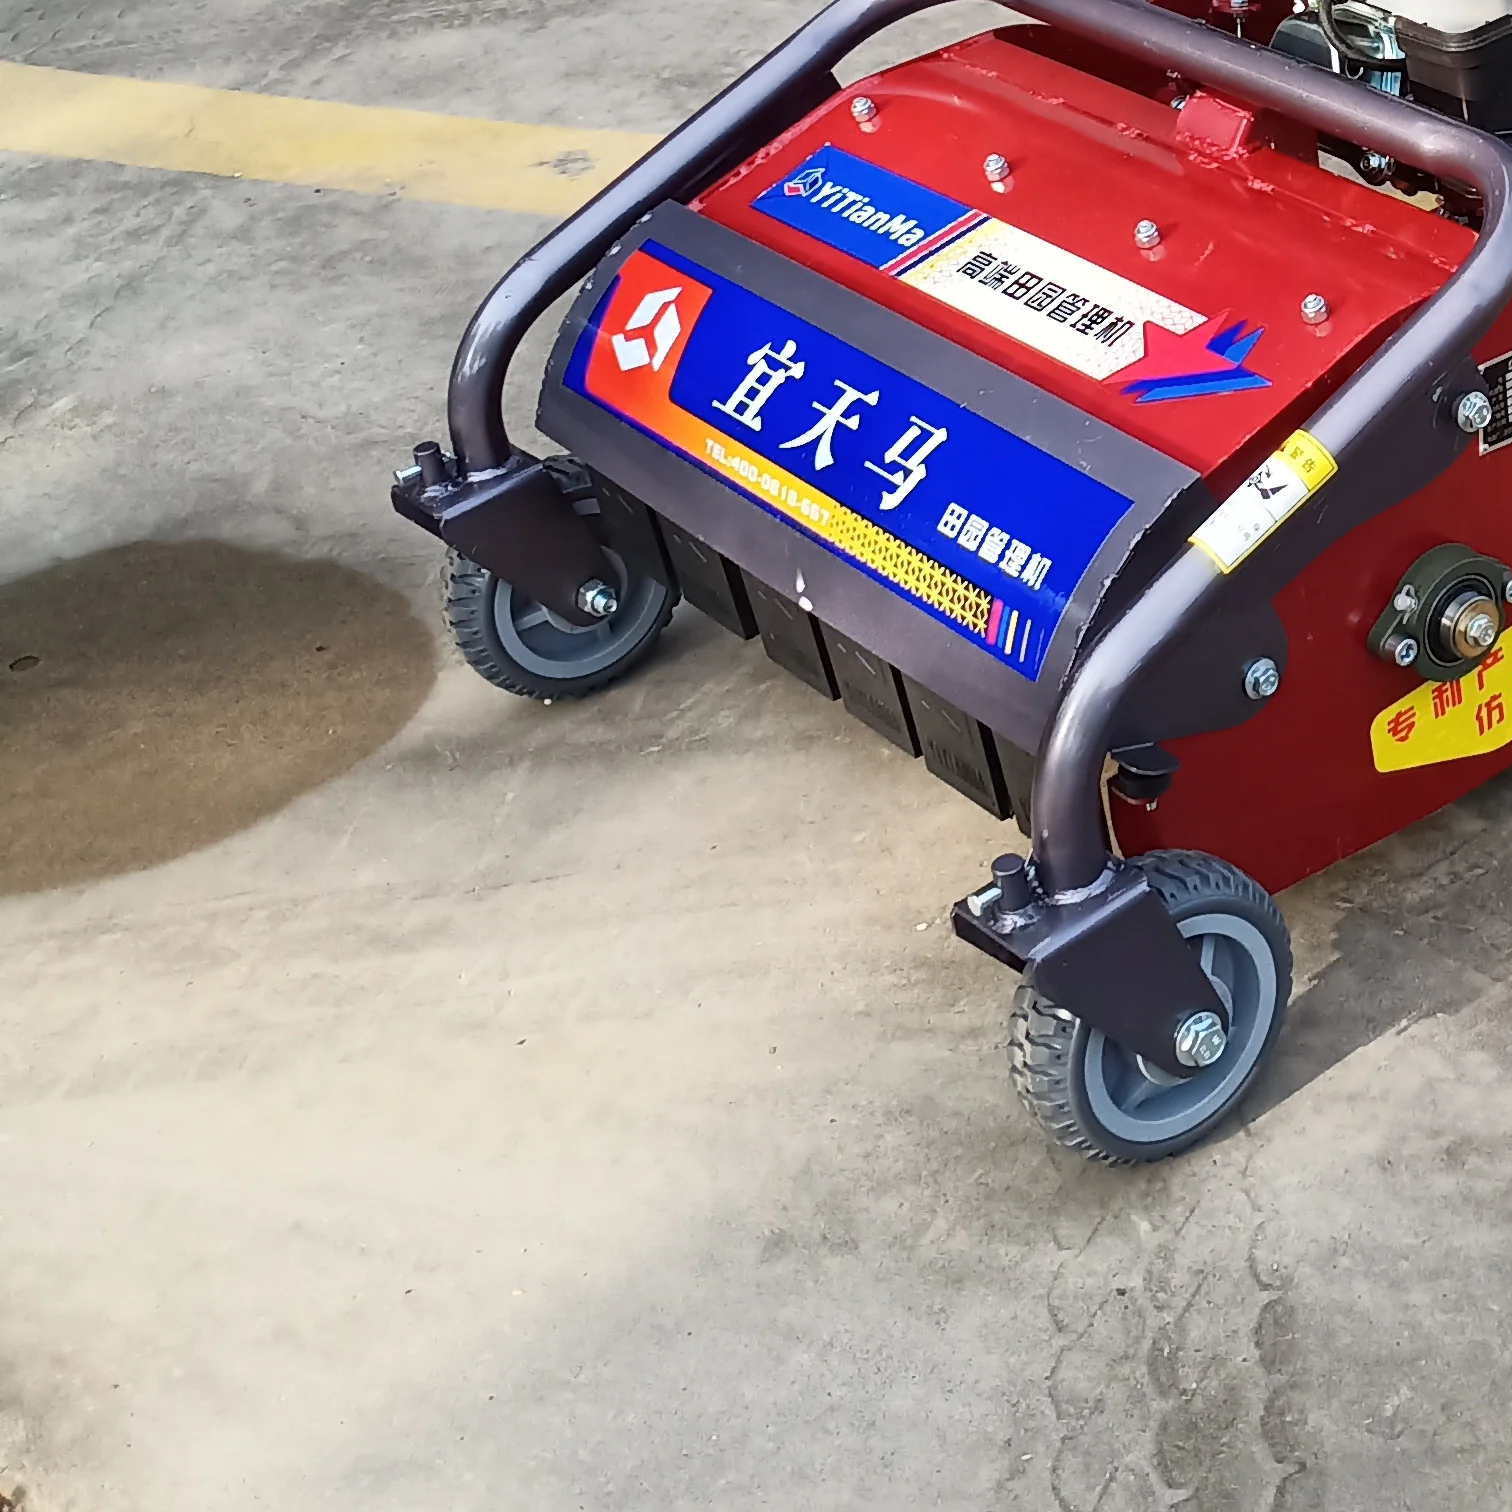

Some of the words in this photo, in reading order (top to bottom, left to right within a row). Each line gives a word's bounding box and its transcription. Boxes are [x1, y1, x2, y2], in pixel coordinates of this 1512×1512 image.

[810, 181, 925, 248] YiTianMa
[956, 250, 1136, 348] 高端田园管理机
[711, 339, 948, 510] 宜天马
[936, 501, 1053, 592] 田园管理机
